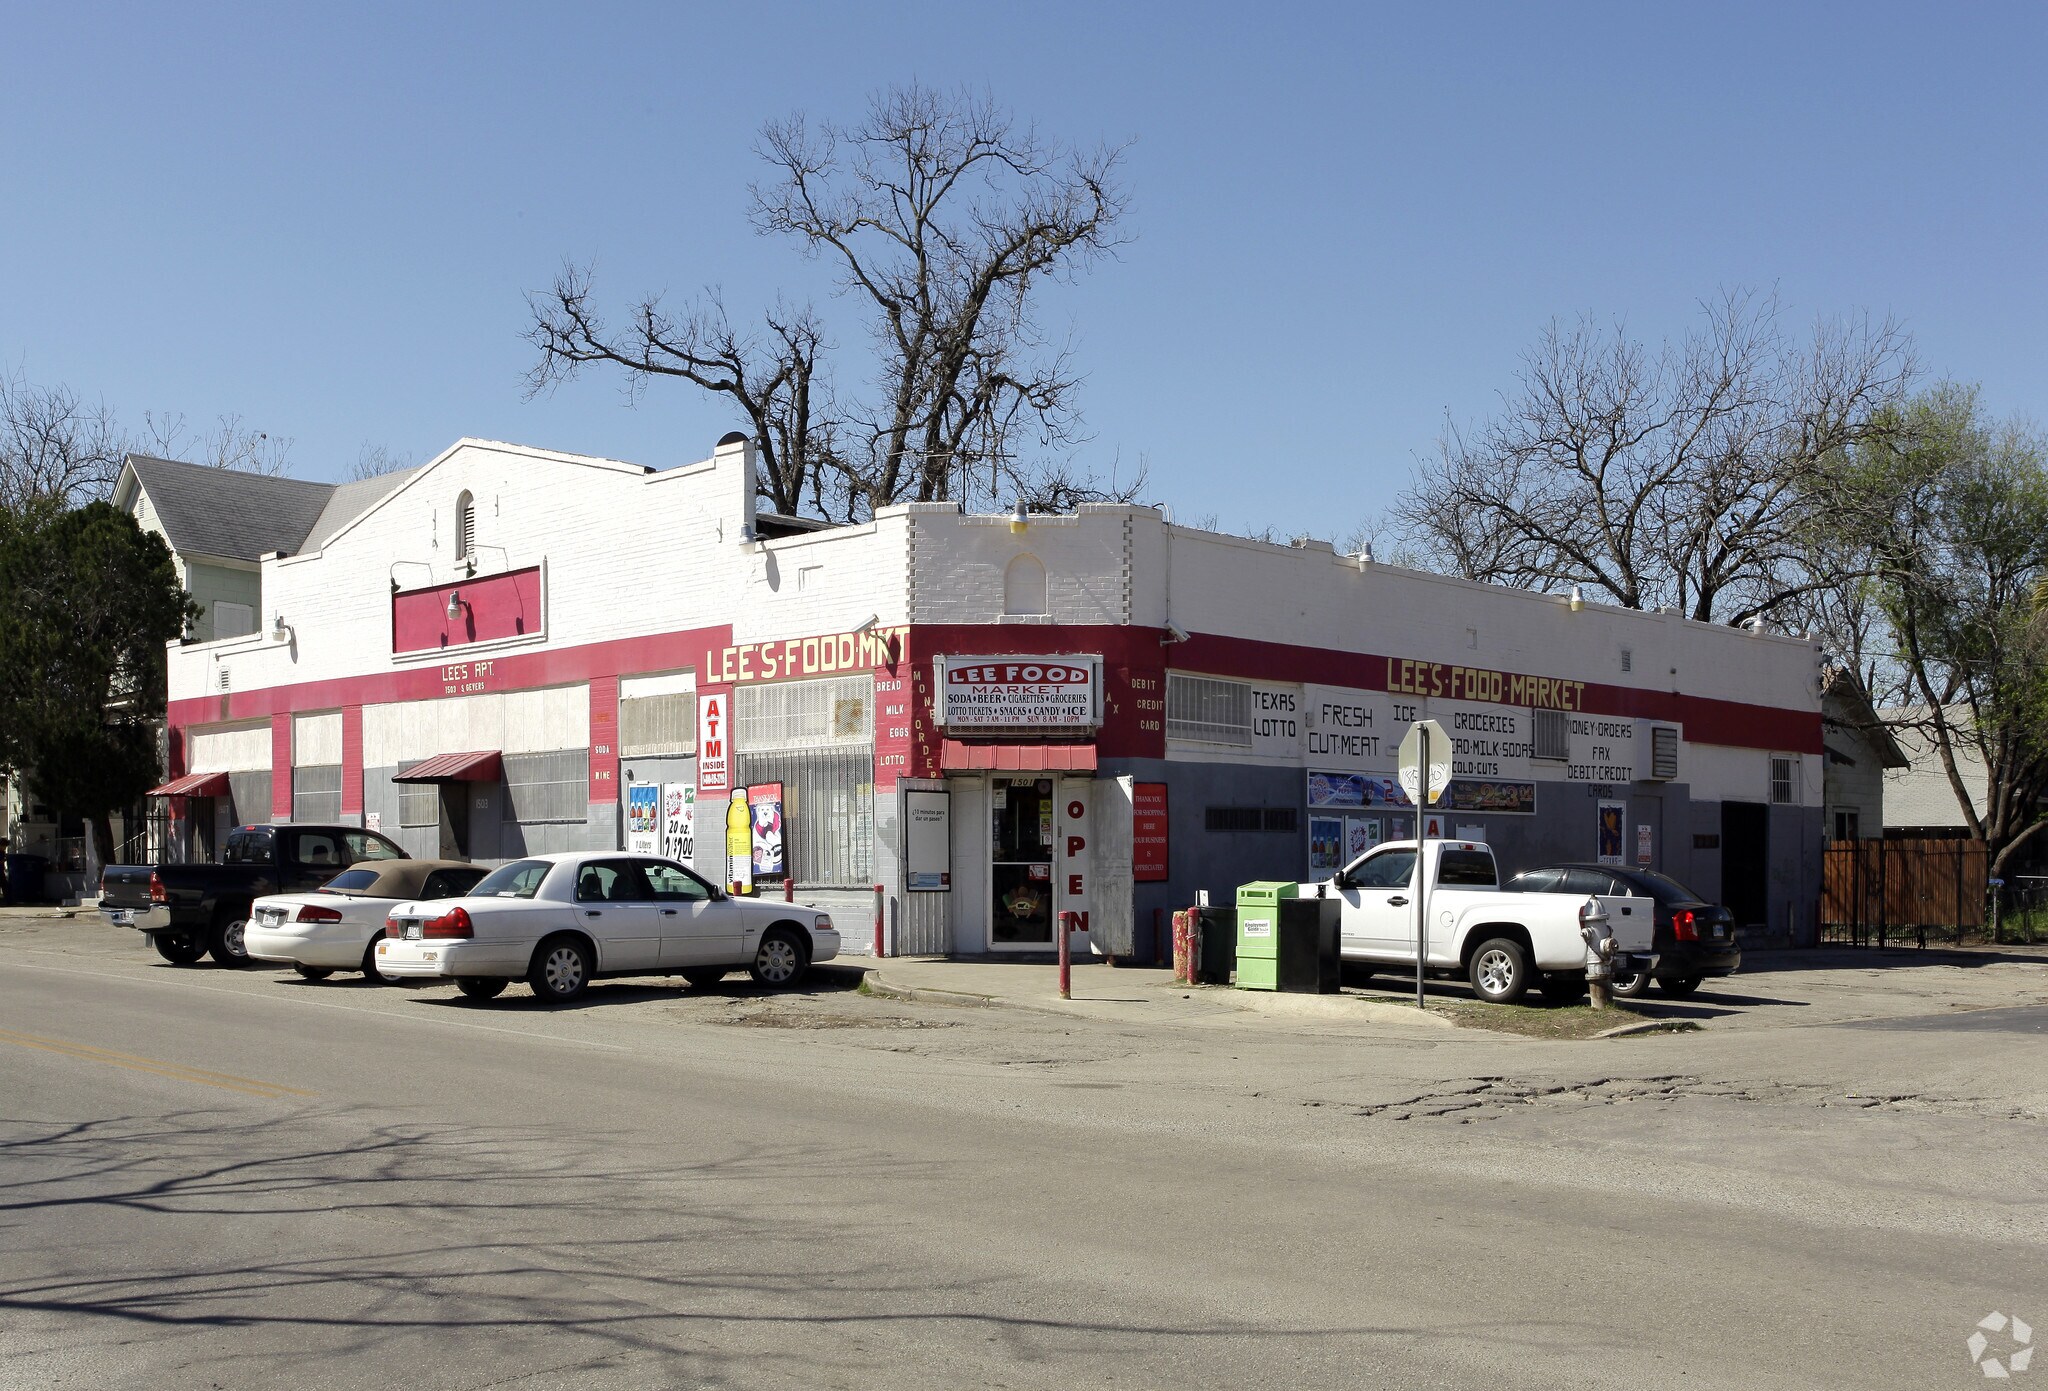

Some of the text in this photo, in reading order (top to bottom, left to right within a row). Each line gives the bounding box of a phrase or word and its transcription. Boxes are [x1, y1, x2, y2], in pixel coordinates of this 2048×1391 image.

[706, 626, 911, 683] LEE'S FOOD MKT
[442, 664, 468, 681] LEE'S
[951, 666, 1085, 682] LEE FOOD
[876, 680, 901, 692] BREAD
[972, 685, 1064, 694] MARKET
[1131, 678, 1156, 690] DEBIT
[1387, 657, 1585, 711] LEE'S FOOD MARKET
[948, 693, 1087, 704] SODA BEER CIGARETTES GROCERIES
[1136, 699, 1164, 711] CREDIT
[1252, 691, 1296, 712] TEXAS
[885, 704, 904, 715] MILK
[947, 706, 1087, 716] LOTTO TICKETS SNACKS CANDY ICE
[1322, 704, 1373, 728] FRESH
[1393, 705, 1417, 722] ICE
[706, 700, 722, 758] ATM
[1140, 719, 1160, 731] CARD
[1254, 718, 1296, 737] LOTTO
[1454, 712, 1515, 734] GROCERIES
[1598, 722, 1632, 738] ORDERS
[889, 727, 909, 738] EGGS
[594, 745, 610, 754] SODA
[1309, 732, 1380, 757] CUT MEAT
[1472, 739, 1499, 757] MILK
[1502, 742, 1534, 759] SODAS
[1592, 746, 1611, 760] FAX
[702, 760, 725, 770] INSIDE
[880, 755, 905, 766] LOTTO
[1452, 761, 1474, 774] COLD
[1476, 762, 1498, 775] CUTS
[1567, 764, 1632, 781] DEBIT CREDIT
[1012, 778, 1034, 786] 1501
[1587, 784, 1613, 799] CARDS
[669, 820, 679, 834] 20
[1067, 800, 1089, 932] OPEN
